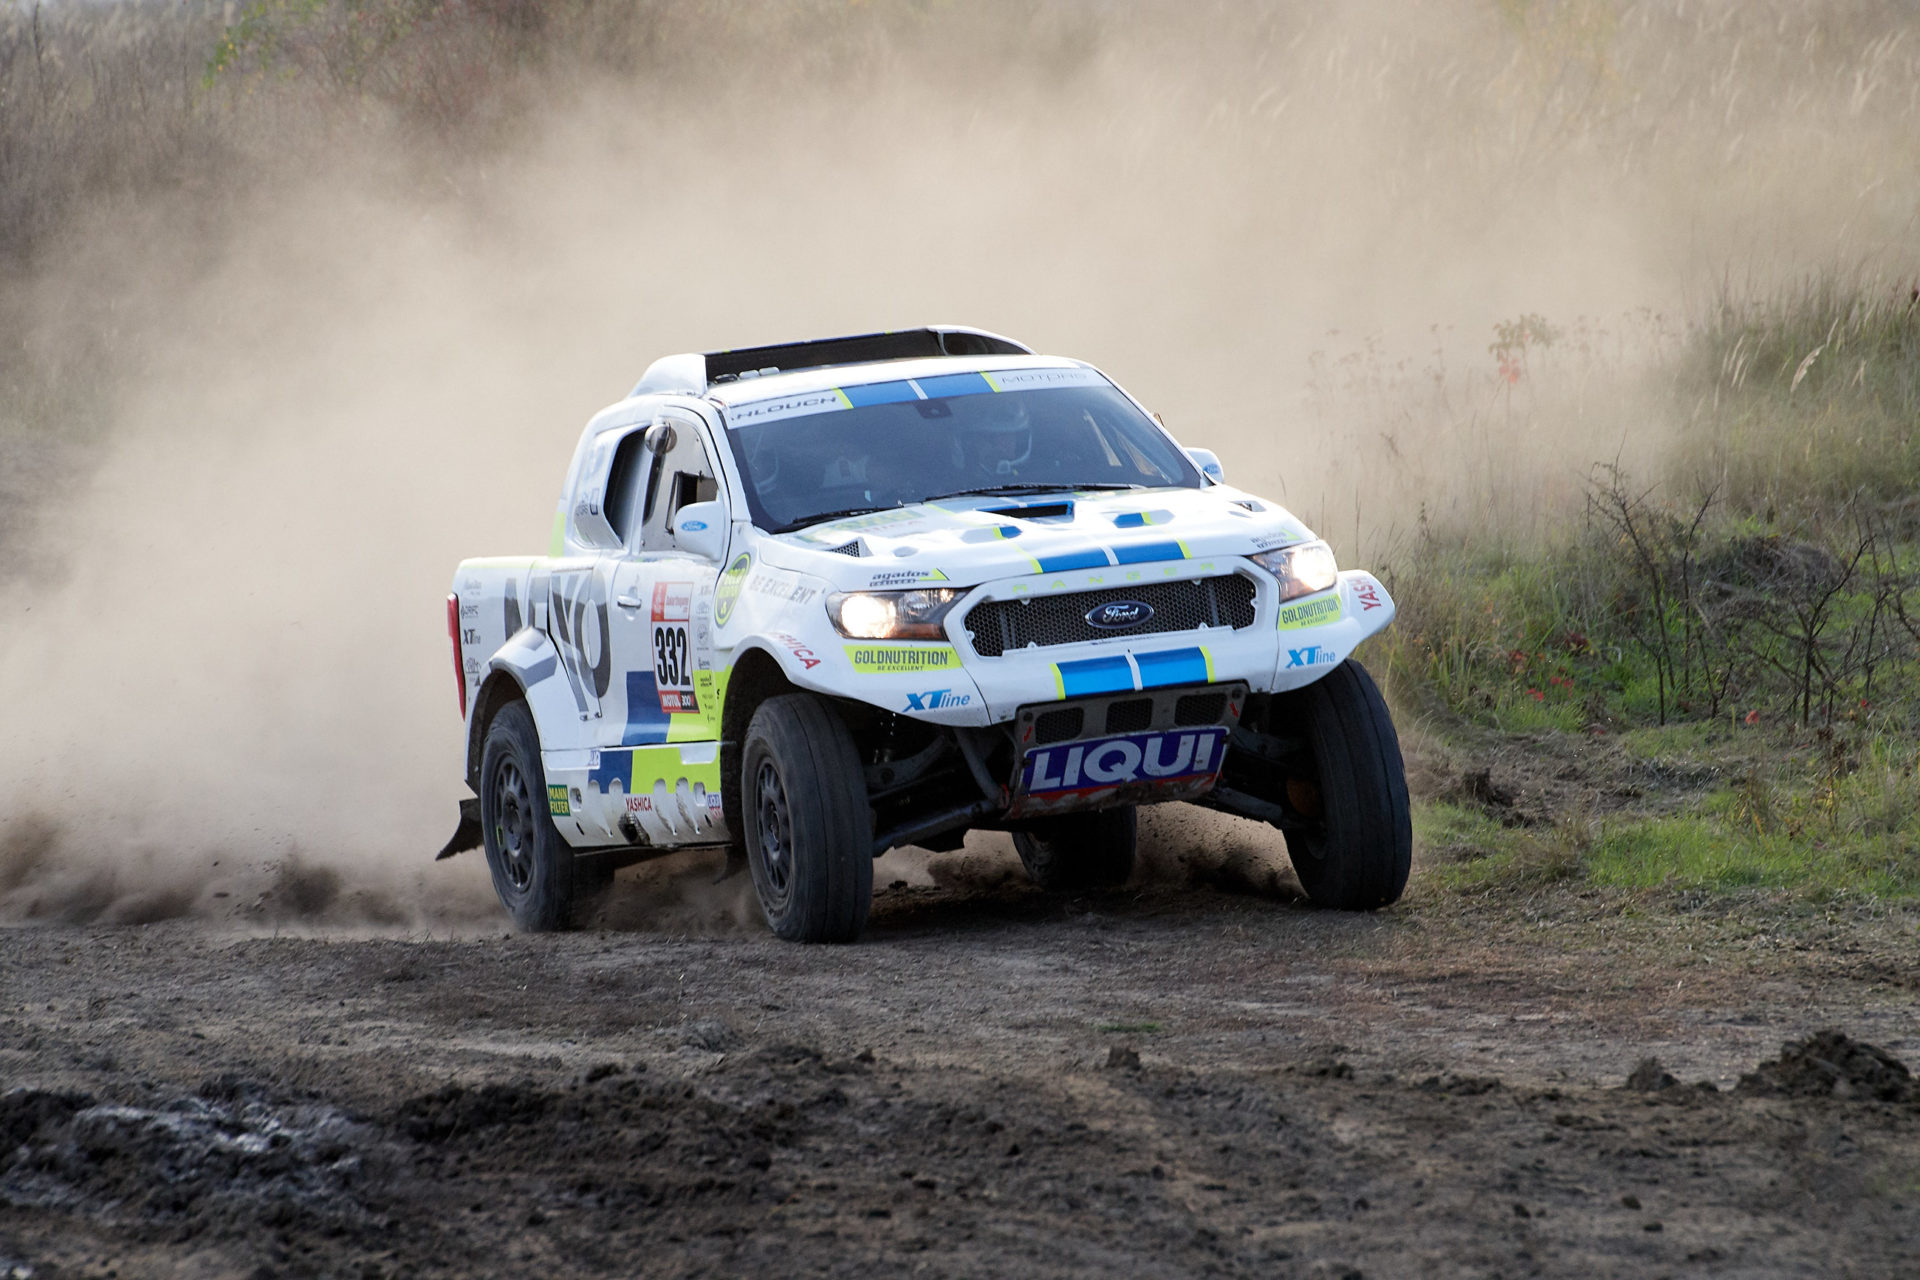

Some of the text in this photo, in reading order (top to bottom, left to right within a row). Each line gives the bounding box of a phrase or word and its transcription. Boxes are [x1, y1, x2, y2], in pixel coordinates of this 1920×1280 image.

[1102, 604, 1139, 623] Ford
[1282, 598, 1339, 624] GOLDNUTRITION
[655, 627, 691, 686] 332
[854, 650, 949, 666] GOLDNUTRITION
[1286, 646, 1336, 668] XTline
[902, 688, 970, 713] XTline
[1030, 733, 1216, 791] LIQUI
[549, 787, 568, 800] MANN
[550, 800, 569, 814] FILTER
[626, 796, 652, 813] YASHICA
